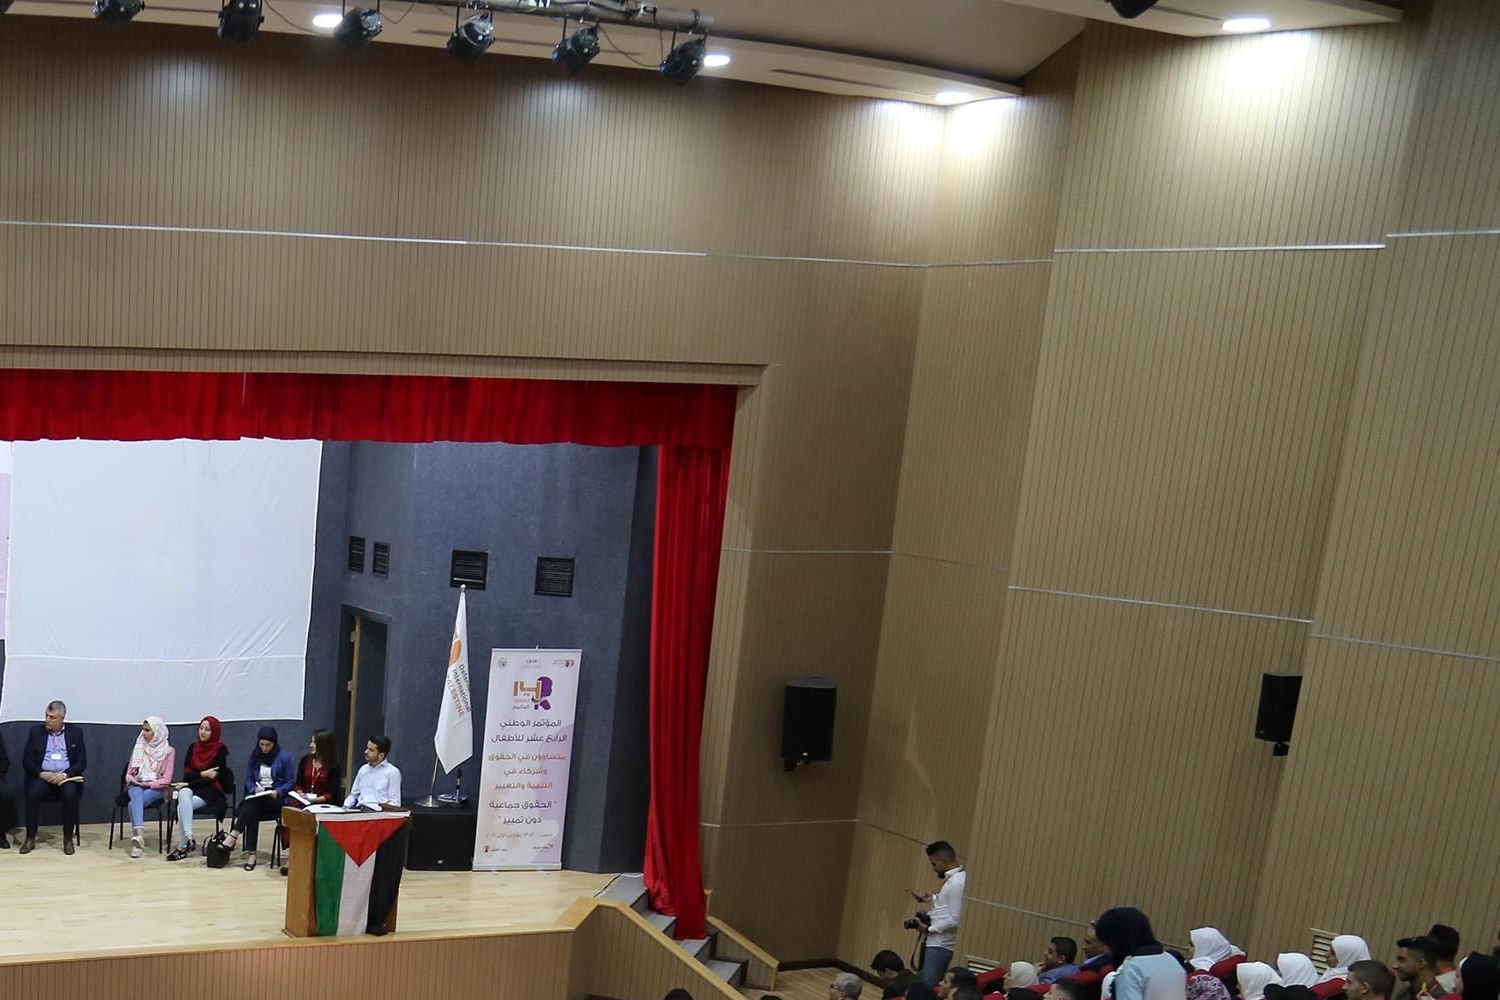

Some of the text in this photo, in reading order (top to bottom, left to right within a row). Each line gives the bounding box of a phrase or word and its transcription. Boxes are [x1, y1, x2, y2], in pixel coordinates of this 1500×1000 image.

[500, 719, 562, 729] المؤتمر الوطني
[491, 732, 568, 744] الرابع عشر للأطفال
[532, 753, 566, 761] متساوون
[494, 782, 553, 790] التنمية والتغيير
[488, 801, 520, 810] جماعية
[522, 801, 552, 810] الحقوق
[503, 816, 524, 825] تمييز
[525, 816, 542, 824] دون
